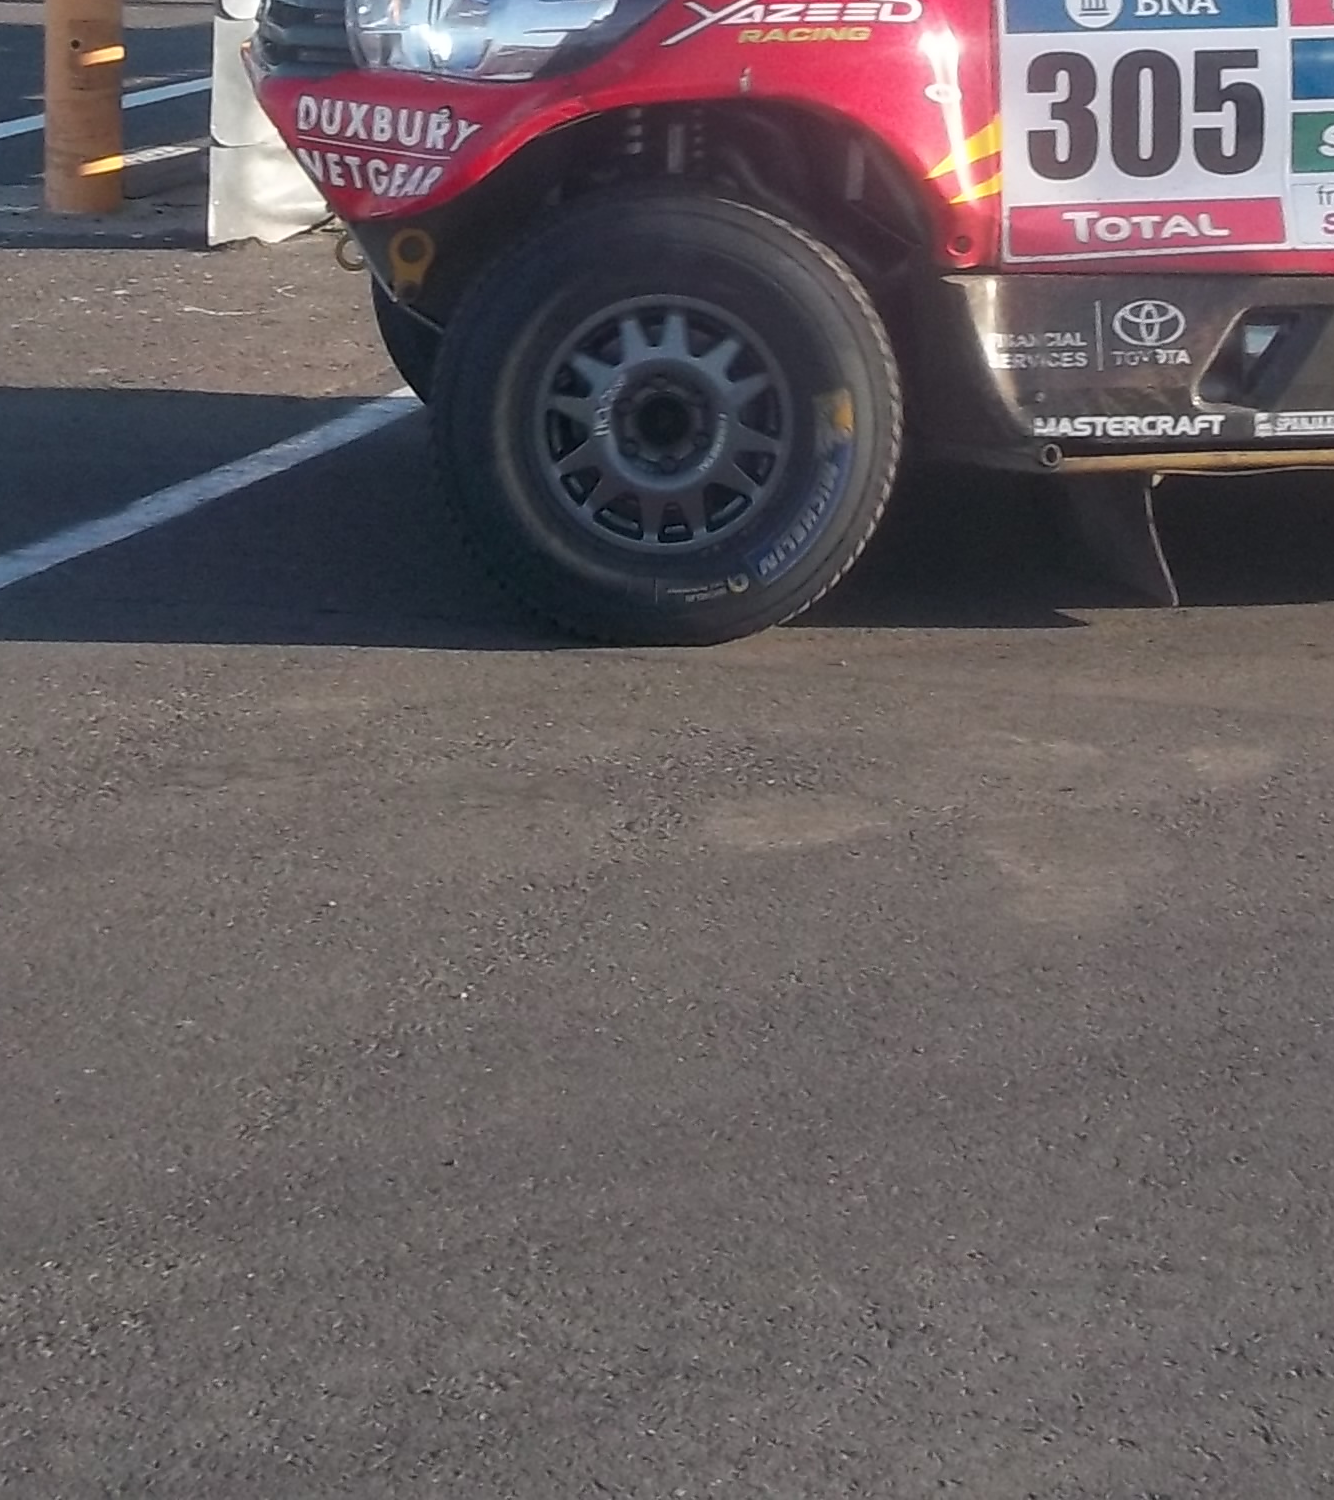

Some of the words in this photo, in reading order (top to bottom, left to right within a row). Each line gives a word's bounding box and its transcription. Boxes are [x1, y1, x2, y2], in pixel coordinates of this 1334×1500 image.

[738, 27, 871, 43] RACING
[296, 95, 482, 152] DUXBURY
[1025, 48, 1264, 181] 305
[296, 147, 444, 197] NETGEAR
[1062, 211, 1232, 243] TOTAL
[1033, 414, 1227, 437] MASTERCRAFT
